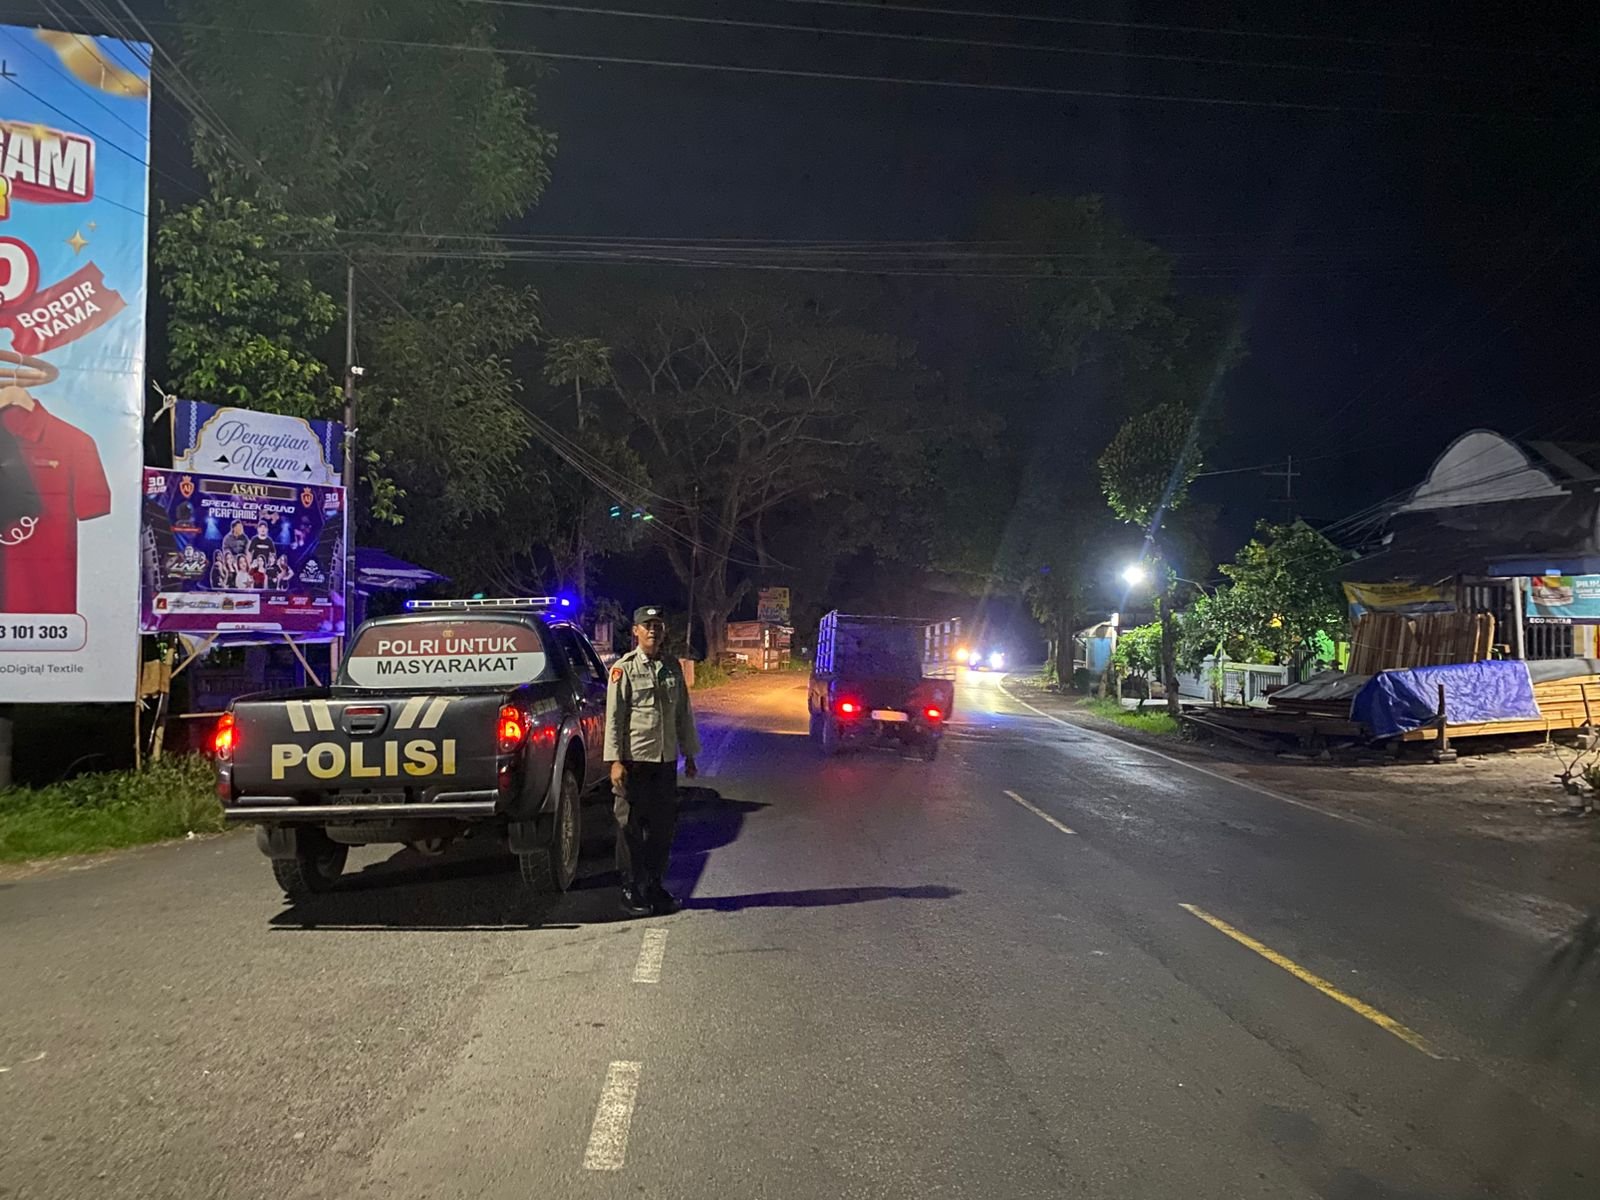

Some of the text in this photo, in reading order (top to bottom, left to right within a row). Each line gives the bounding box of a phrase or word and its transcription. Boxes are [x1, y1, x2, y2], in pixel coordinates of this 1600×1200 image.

[0, 128, 88, 197] AM
[16, 281, 97, 329] BORDIR
[34, 300, 101, 341] NAMA
[216, 421, 310, 452] Pengajian
[231, 445, 300, 477] Umum
[148, 476, 165, 487] 30
[231, 483, 268, 497] ASATU
[201, 499, 295, 514] SPECIAL CEK SOUND
[325, 493, 339, 502] 30
[11, 625, 34, 639] 101
[38, 626, 68, 639] 303
[378, 637, 517, 655] POLRI UNTUK
[48, 664, 84, 673] Textile
[377, 657, 518, 675] MASYARAKAT
[271, 738, 456, 780] POLISI
